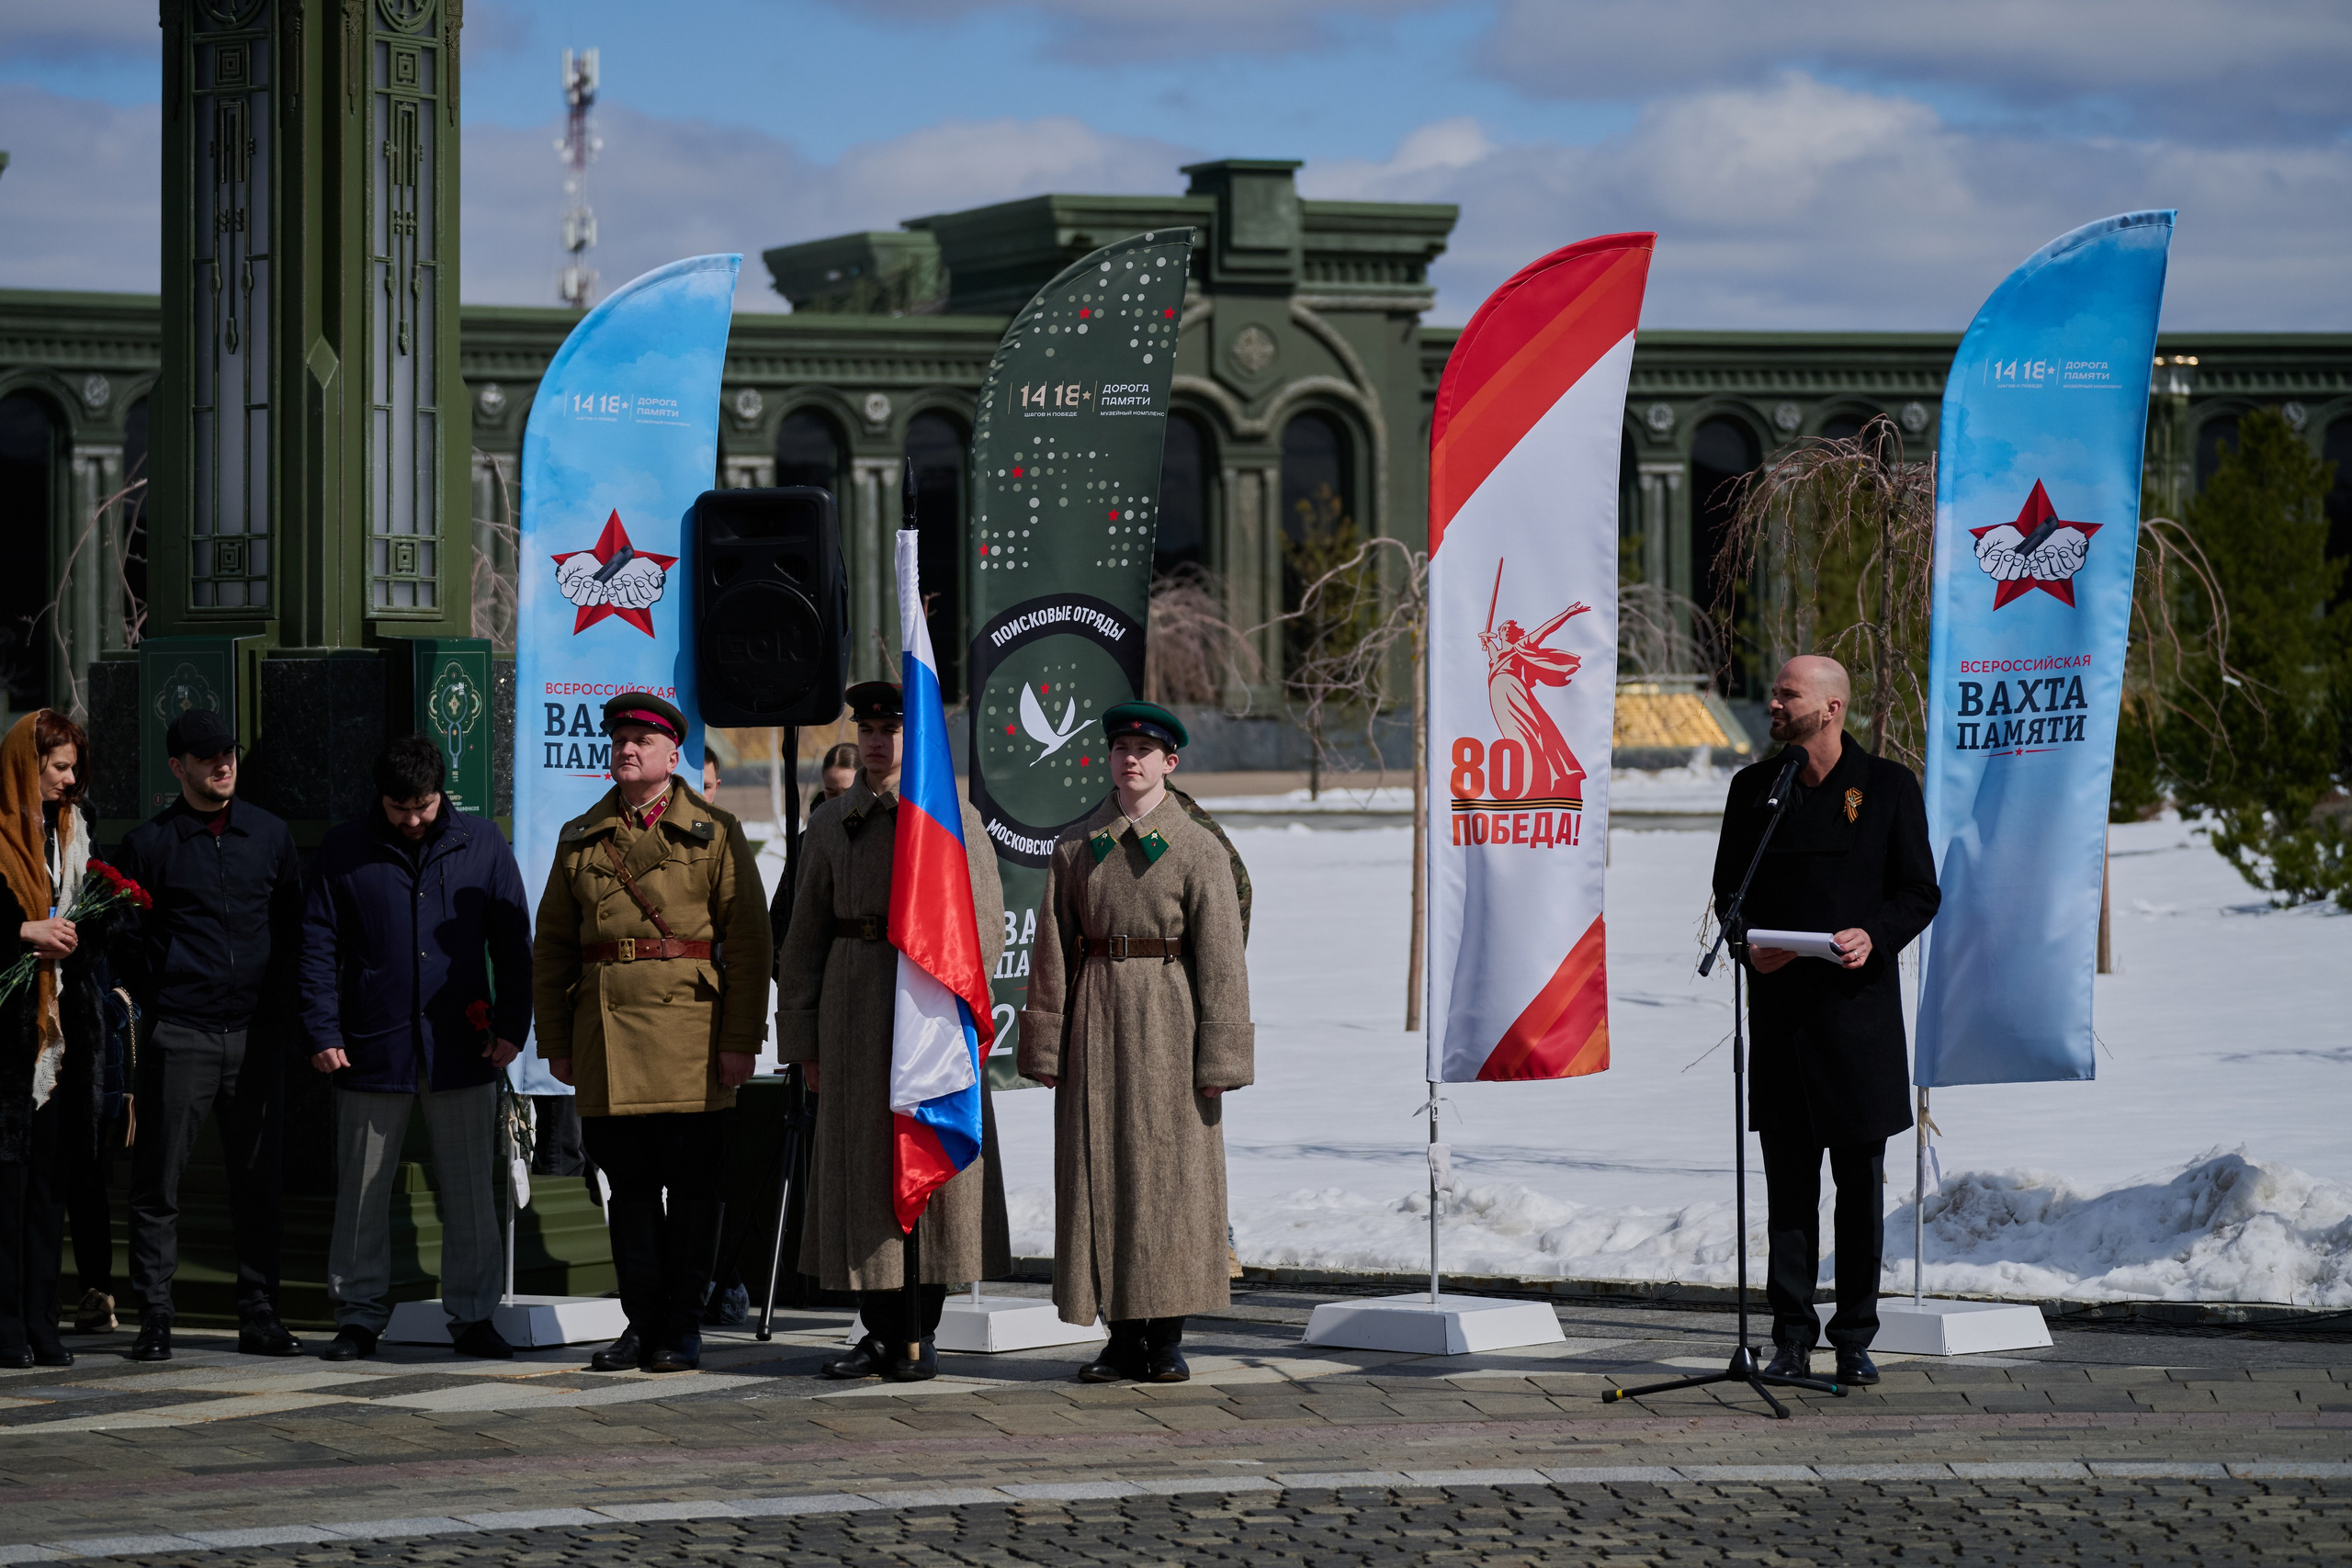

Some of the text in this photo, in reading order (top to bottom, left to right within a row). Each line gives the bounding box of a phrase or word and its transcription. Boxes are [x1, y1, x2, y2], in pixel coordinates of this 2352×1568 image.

[2064, 372, 2109, 380] ПАМЯТИ
[2065, 361, 2108, 369] ДОРОГА
[1102, 384, 1149, 394] ДОРОГА
[637, 407, 679, 418] ПАМЯТИ
[638, 397, 677, 407] ДОРОГА
[1101, 396, 1150, 406] ПАМЯТИ
[990, 605, 1126, 647] ПОИСКОВЫЕ ОТРЯДЫ
[1961, 654, 2091, 673] ВСЕРОССИЙСКАЯ
[1958, 675, 2087, 716] ВАХТА
[1956, 715, 2086, 750] ПАМЯТИ
[544, 742, 611, 769] ПАМ
[1450, 737, 1524, 800] 80
[986, 818, 1058, 855] МОСКОВСКО
[1452, 812, 1581, 849] ПОБЕДА!
